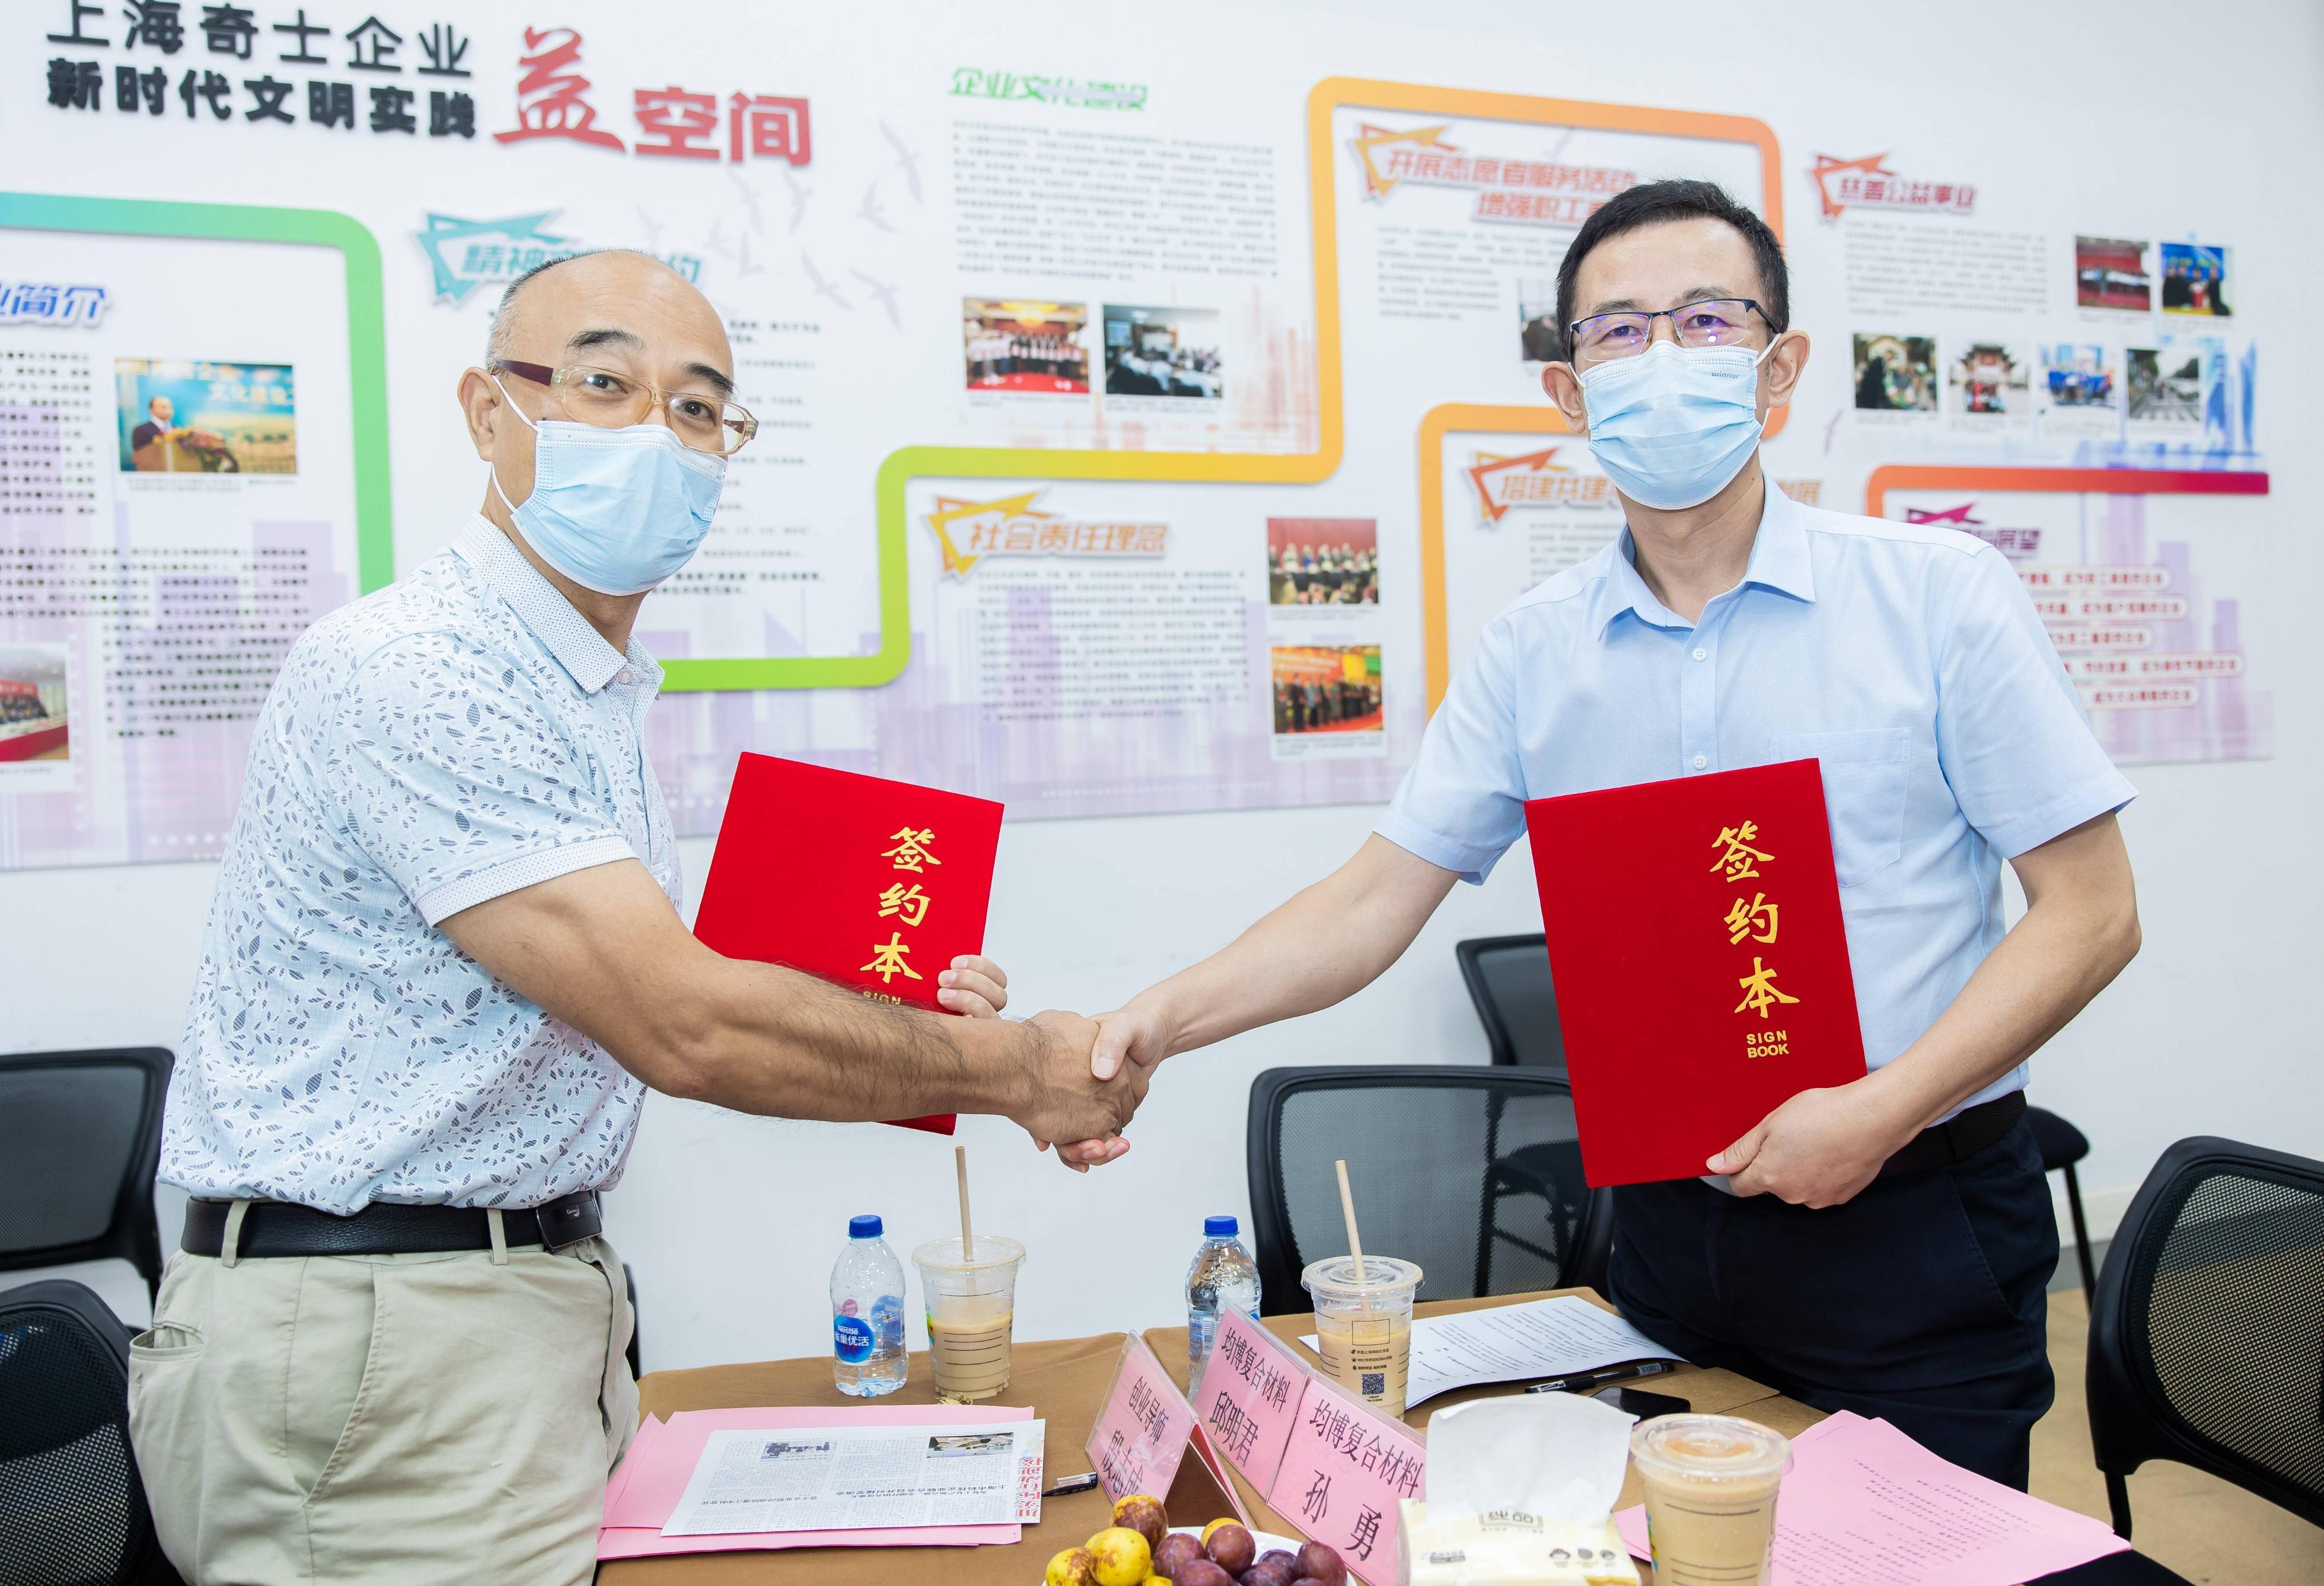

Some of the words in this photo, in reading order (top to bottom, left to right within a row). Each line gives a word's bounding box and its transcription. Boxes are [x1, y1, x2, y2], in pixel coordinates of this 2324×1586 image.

[47, 0, 471, 77] 上海奇士企业
[47, 58, 476, 139] 新时代文明实践
[493, 25, 811, 167] 益空间
[948, 66, 1148, 111] 企业文化建设
[1386, 149, 1636, 194] 开展志愿者服务活动
[1838, 175, 1977, 208] 慈善公益事业
[1477, 192, 1608, 223] 增强职工
[1711, 371, 1740, 379] winner
[970, 522, 1168, 553] 社会责任理念
[860, 827, 941, 984] 签约本
[1710, 820, 1800, 1019] 签约本
[863, 991, 901, 1005] SIGN
[1746, 1030, 1787, 1045] SIGN
[1748, 1043, 1789, 1059] BOOK
[1220, 1326, 1291, 1413] 均博复合材料
[1128, 1375, 1170, 1445] 创业导师
[1209, 1390, 1258, 1467] 邱明君
[1309, 1398, 1424, 1497] 均博复合材料
[1302, 1469, 1328, 1524] 孙
[1345, 1503, 1382, 1562] 勇
